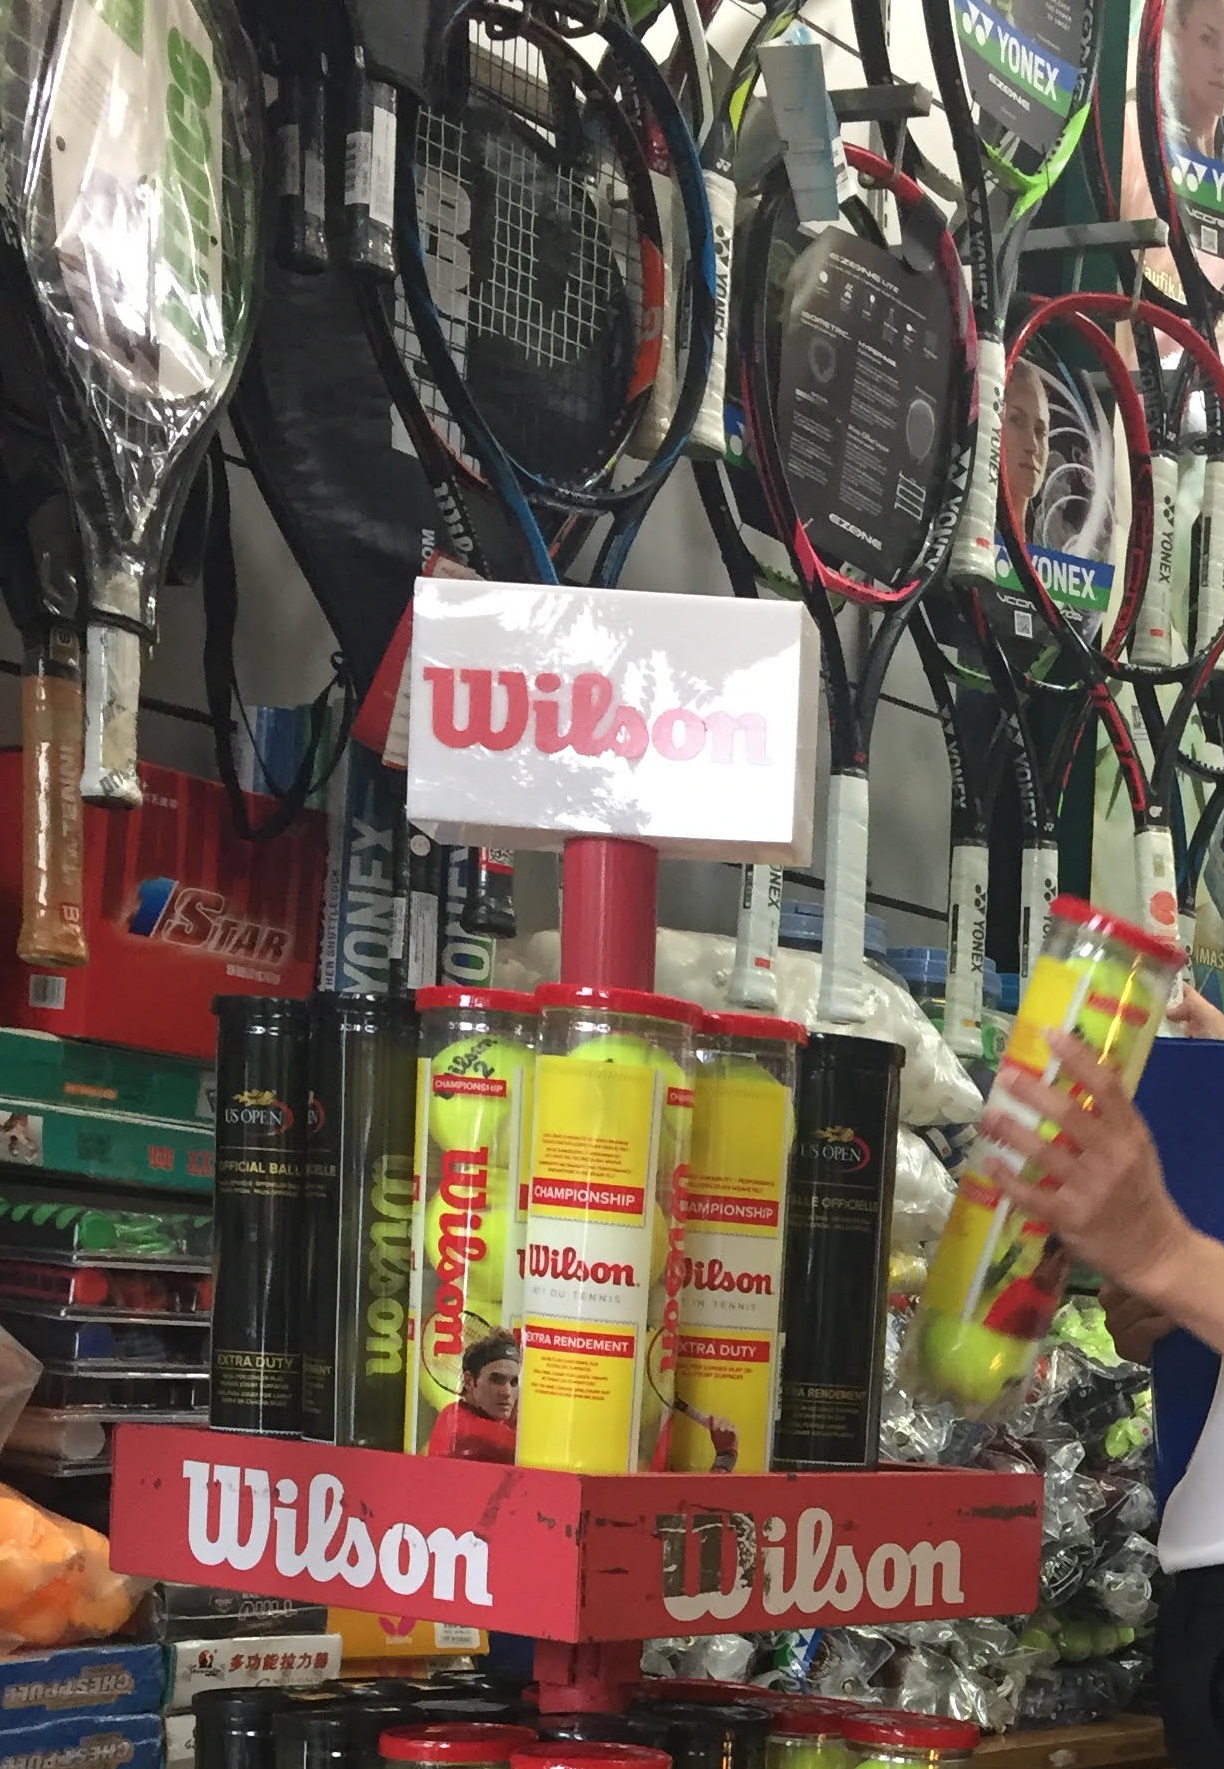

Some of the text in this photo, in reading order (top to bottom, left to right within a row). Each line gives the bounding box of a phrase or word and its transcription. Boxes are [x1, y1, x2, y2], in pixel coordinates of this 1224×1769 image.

[997, 25, 1059, 102] YONEX
[1143, 259, 1176, 296] aufik
[1158, 530, 1175, 585] YONEX
[422, 666, 773, 766] Wilson
[341, 815, 395, 994] YONEX
[970, 918, 986, 973] YONEX
[434, 1079, 504, 1093] CHAMPIONSHIP
[224, 1107, 282, 1126] US OPEN
[822, 1143, 862, 1162] OPEN
[533, 1184, 636, 1207] CHAMPIONSHIP
[433, 1146, 490, 1358] Wilson
[528, 1243, 636, 1288] Wilson
[217, 1354, 294, 1370] EXTRA DUTY
[553, 1334, 630, 1353] RENDEMENT
[719, 1344, 758, 1358] DUTY
[182, 1459, 494, 1607] Wilson
[654, 1506, 965, 1622] Wilson
